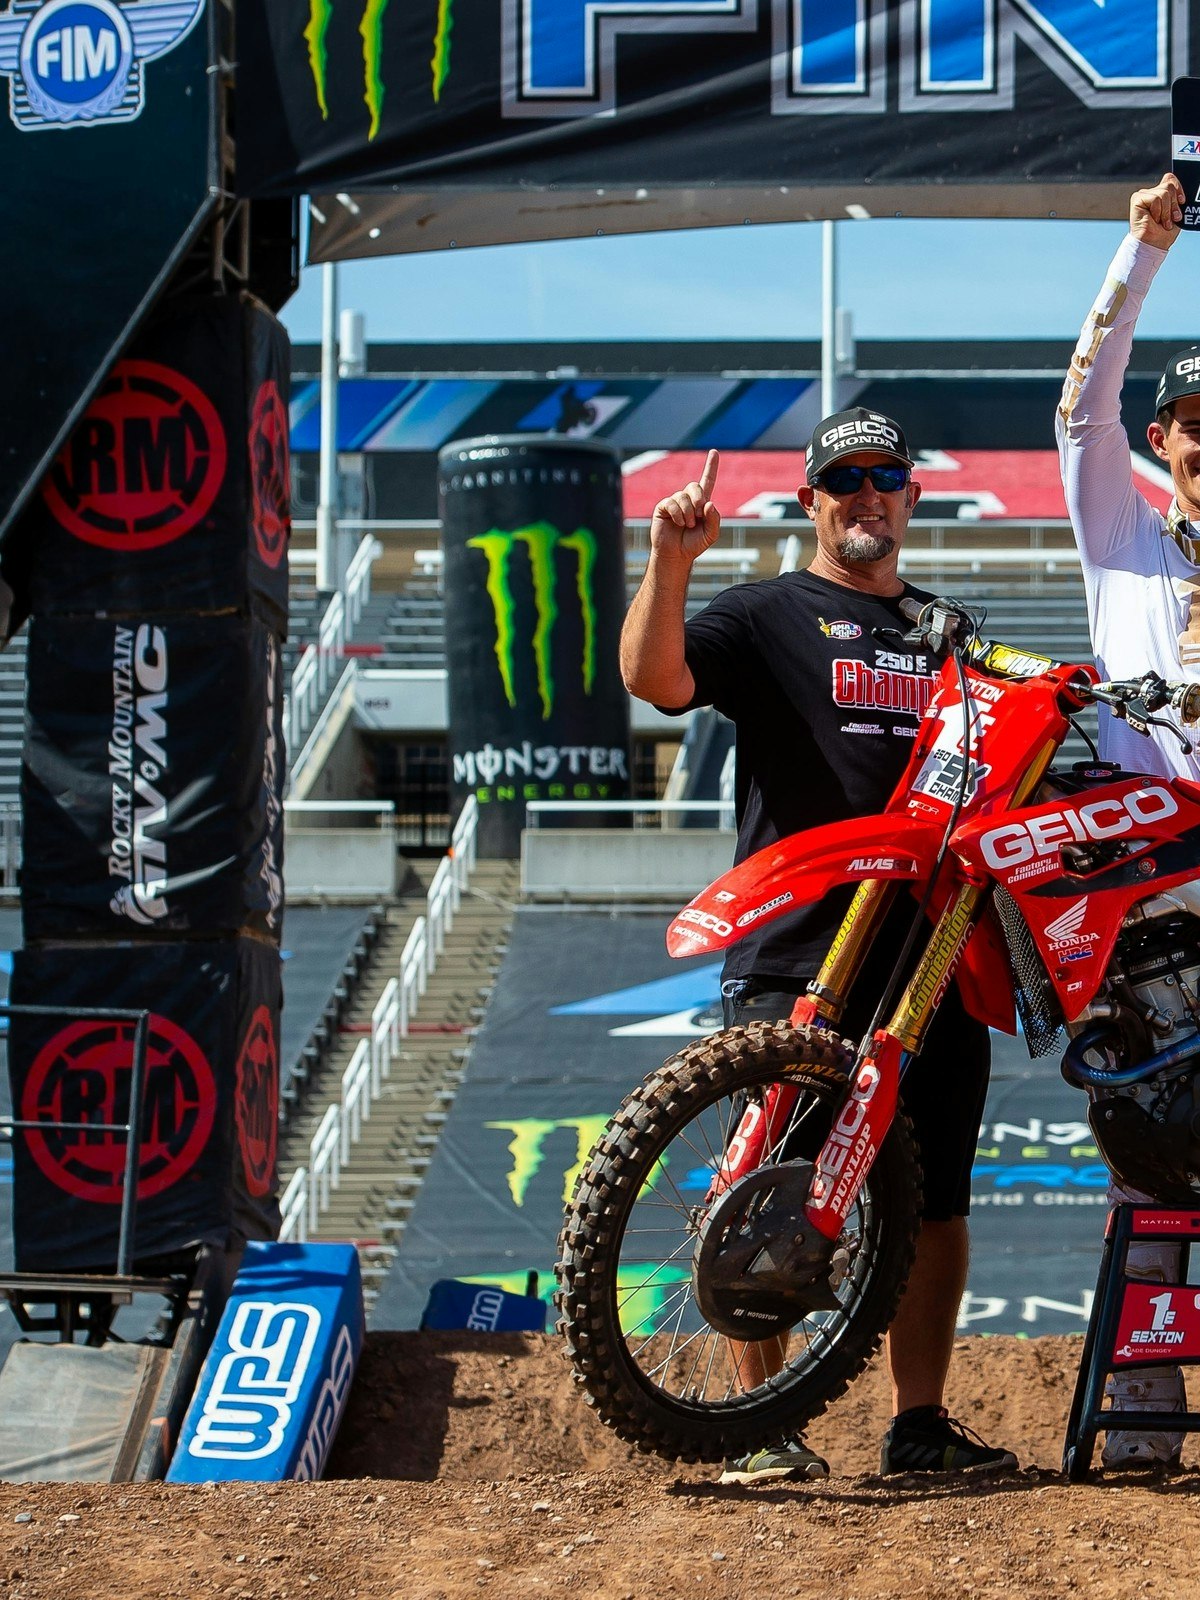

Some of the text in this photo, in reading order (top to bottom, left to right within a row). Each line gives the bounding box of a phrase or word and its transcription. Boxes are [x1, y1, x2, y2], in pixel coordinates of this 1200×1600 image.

[36, 25, 117, 82] FIM
[821, 421, 899, 448] GEICO
[832, 435, 897, 452] HONDA
[875, 649, 927, 673] 250 E
[832, 658, 944, 723] Champ
[892, 725, 920, 737] GEIC
[108, 624, 136, 882] ROCKY MOUNTAIN
[453, 741, 629, 786] MONSTER
[979, 786, 1179, 870] GEICO
[1015, 857, 1052, 875] Factory
[678, 908, 734, 937] GEICO
[672, 925, 709, 946] HONDA
[1047, 932, 1100, 951] HONDA
[1058, 943, 1094, 964] HRC
[781, 1063, 848, 1083] DUNLO
[806, 1064, 882, 1211] GEICO
[829, 1123, 872, 1215] DUNLOP
[747, 1311, 779, 1322] MOTOSTUFF
[1130, 1330, 1185, 1344] SEXTON
